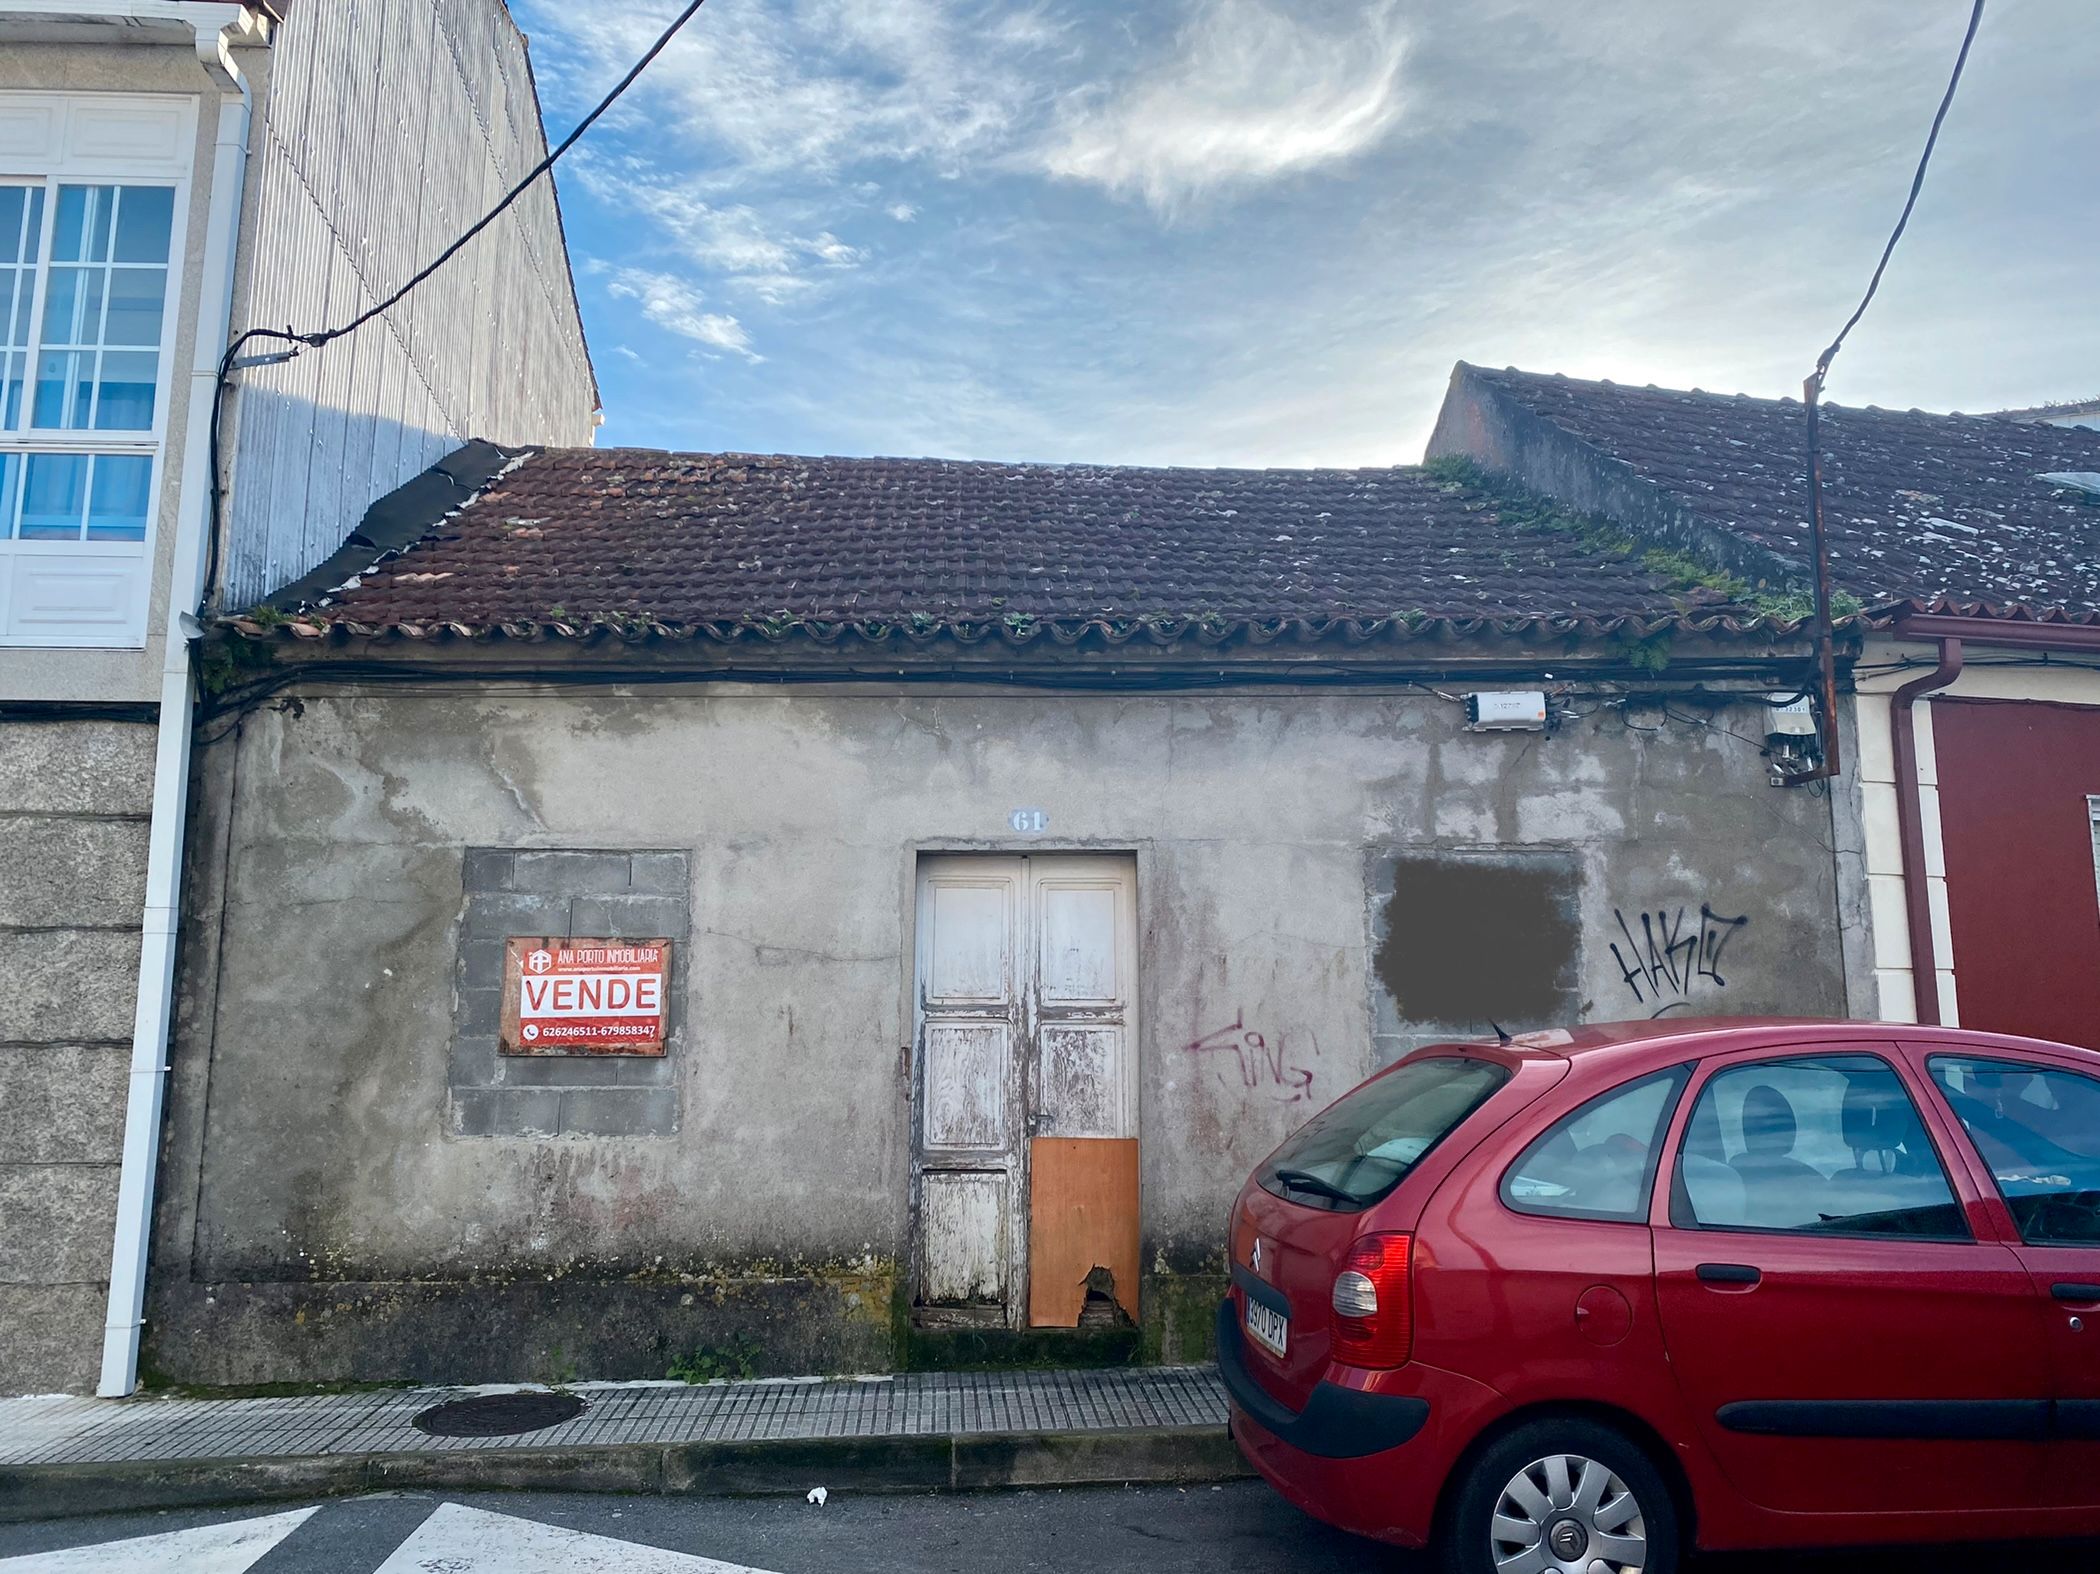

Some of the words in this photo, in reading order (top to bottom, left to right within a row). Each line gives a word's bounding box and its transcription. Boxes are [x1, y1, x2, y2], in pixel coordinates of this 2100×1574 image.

[1013, 811, 1041, 831] 61
[558, 950, 575, 964] ANA
[577, 950, 606, 964] PORTO
[607, 948, 659, 964] INMOBILIARIA
[525, 978, 657, 1012] VENDE
[543, 1025, 656, 1037] 626246511-679858347
[1268, 1311, 1285, 1347] DPX
